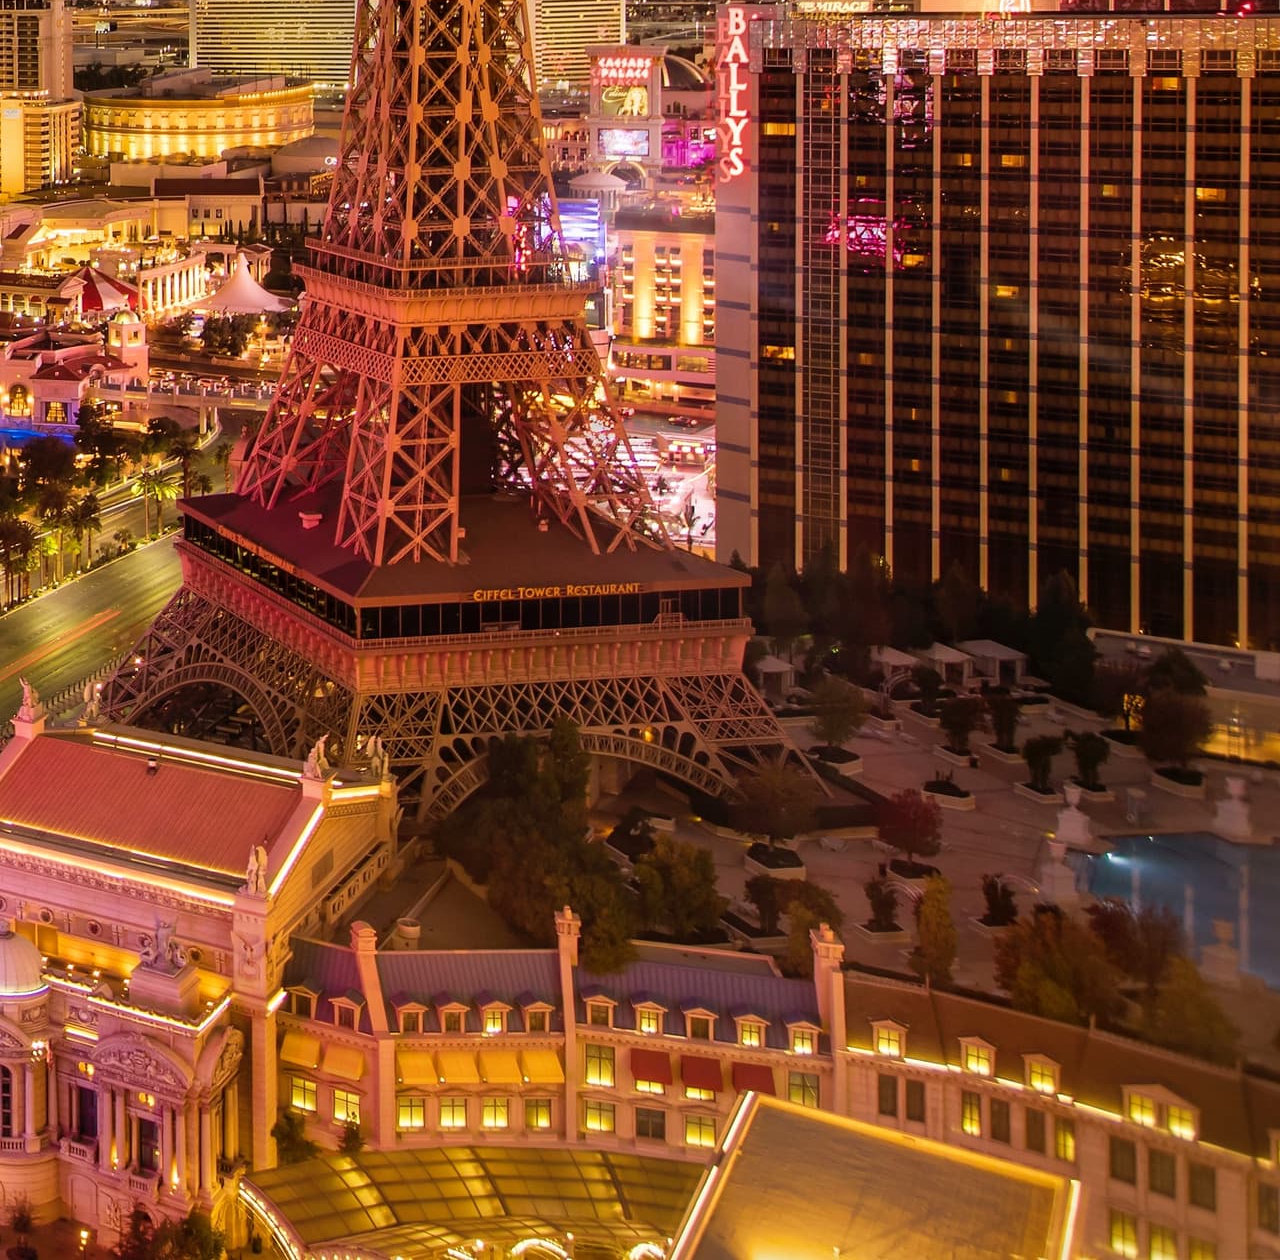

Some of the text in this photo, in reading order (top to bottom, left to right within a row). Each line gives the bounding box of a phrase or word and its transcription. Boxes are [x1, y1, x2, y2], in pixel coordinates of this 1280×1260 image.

[816, 1, 870, 13] MIRAGE
[598, 58, 652, 68] CAESARS
[600, 68, 649, 78] PALACE
[473, 582, 641, 602] EIFFEL TOWER RESTAURANT
